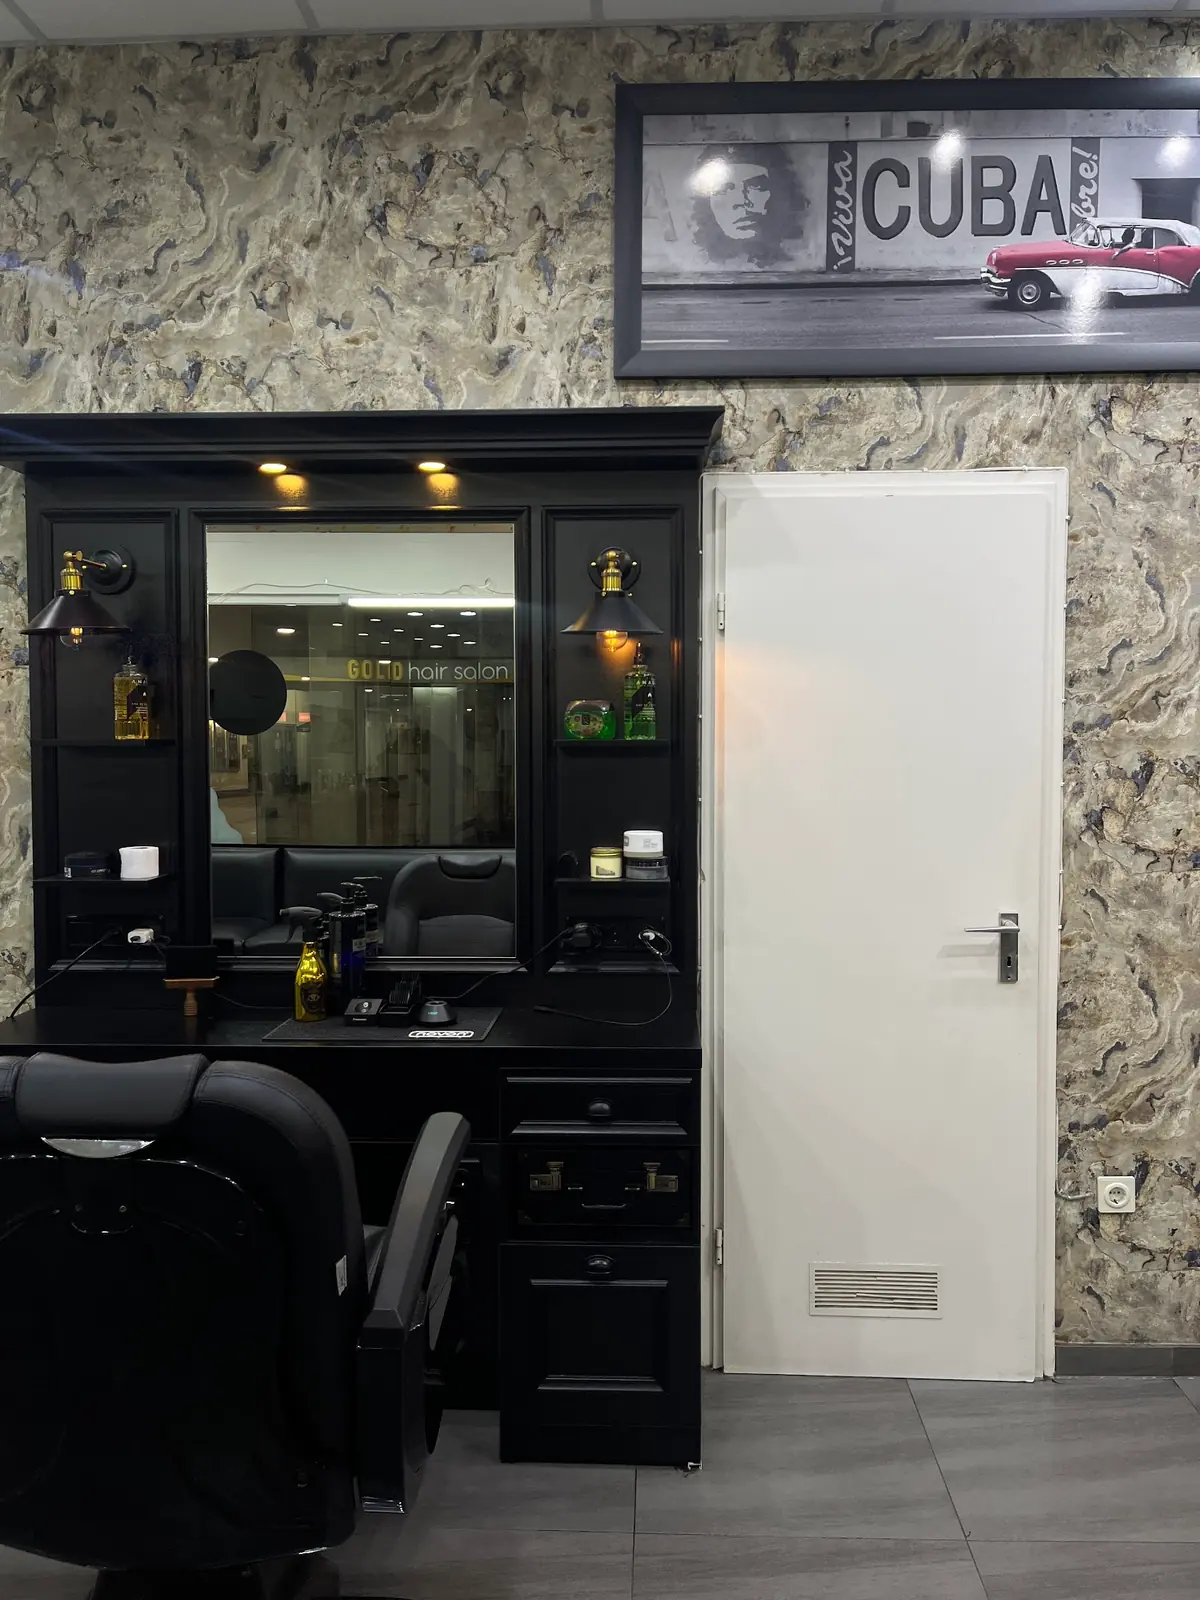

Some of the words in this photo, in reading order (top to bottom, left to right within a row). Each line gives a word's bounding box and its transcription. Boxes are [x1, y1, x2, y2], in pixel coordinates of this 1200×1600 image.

[861, 154, 1067, 240] CUBA
[408, 662, 448, 680] hair
[454, 662, 508, 680] salon
